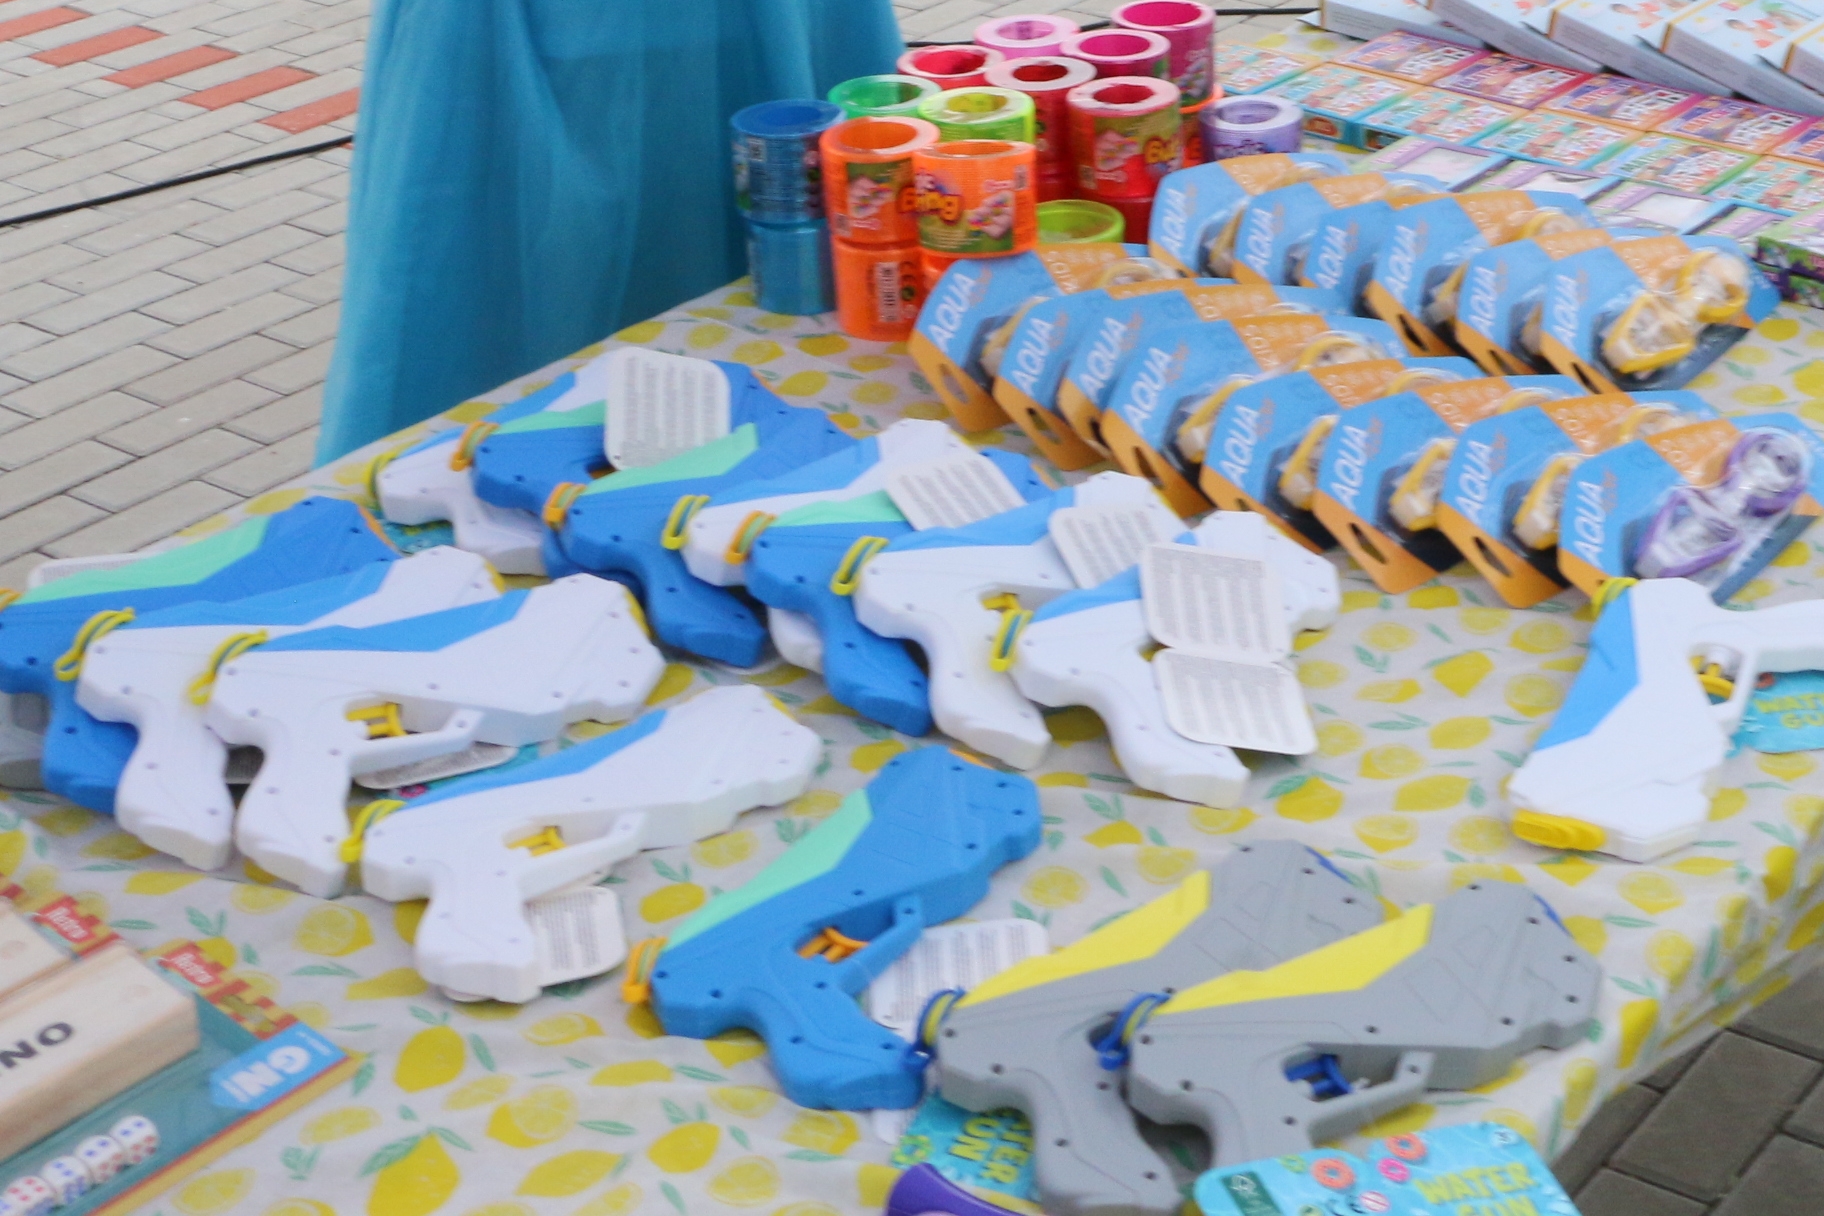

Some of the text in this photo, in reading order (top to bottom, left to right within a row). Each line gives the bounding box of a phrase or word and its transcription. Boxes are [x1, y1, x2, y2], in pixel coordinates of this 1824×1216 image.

[1159, 188, 1188, 259] AQUA
[1245, 208, 1274, 280] AQUA
[1316, 225, 1347, 290] AQUA
[1385, 225, 1417, 305] AQUA
[1469, 266, 1497, 339] AQUA
[927, 272, 977, 353] AQUA
[1552, 273, 1579, 350] AQUA
[1011, 317, 1054, 395] AQUA
[1077, 317, 1128, 403] AQUA
[1124, 347, 1172, 433] AQUA
[1219, 405, 1260, 488] AQUA
[1329, 425, 1369, 510] AQUA
[1454, 439, 1494, 520] AQUA
[1571, 480, 1606, 566] AQUA
[0, 1020, 75, 1074] NO
[1413, 1162, 1538, 1206] WATER
